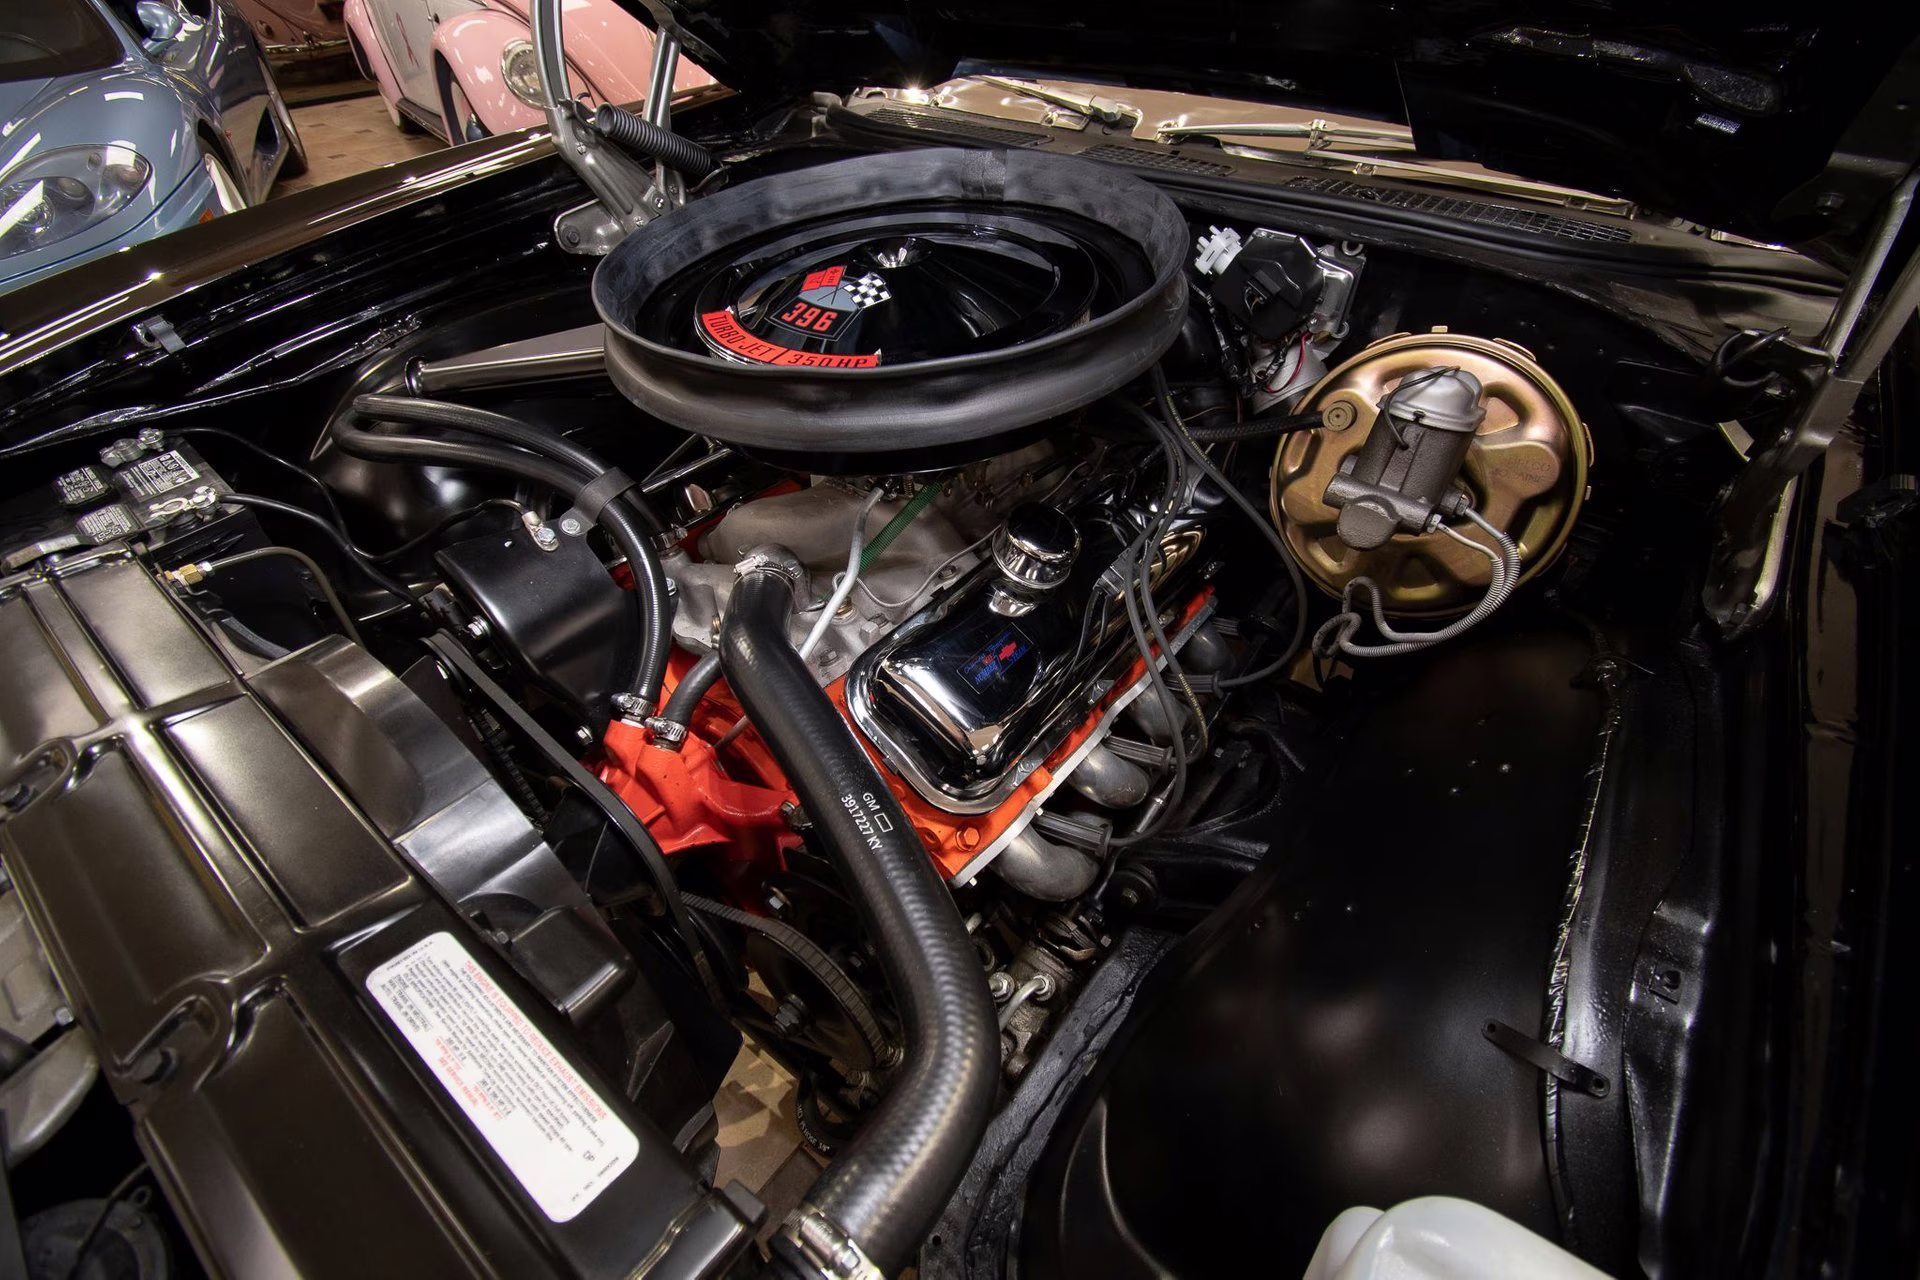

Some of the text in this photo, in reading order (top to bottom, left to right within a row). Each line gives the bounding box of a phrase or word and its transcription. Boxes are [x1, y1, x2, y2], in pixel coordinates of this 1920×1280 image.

[781, 302, 838, 332] 396
[788, 354, 832, 367] 350
[862, 792, 880, 811] GM
[841, 794, 874, 835] 3917227
